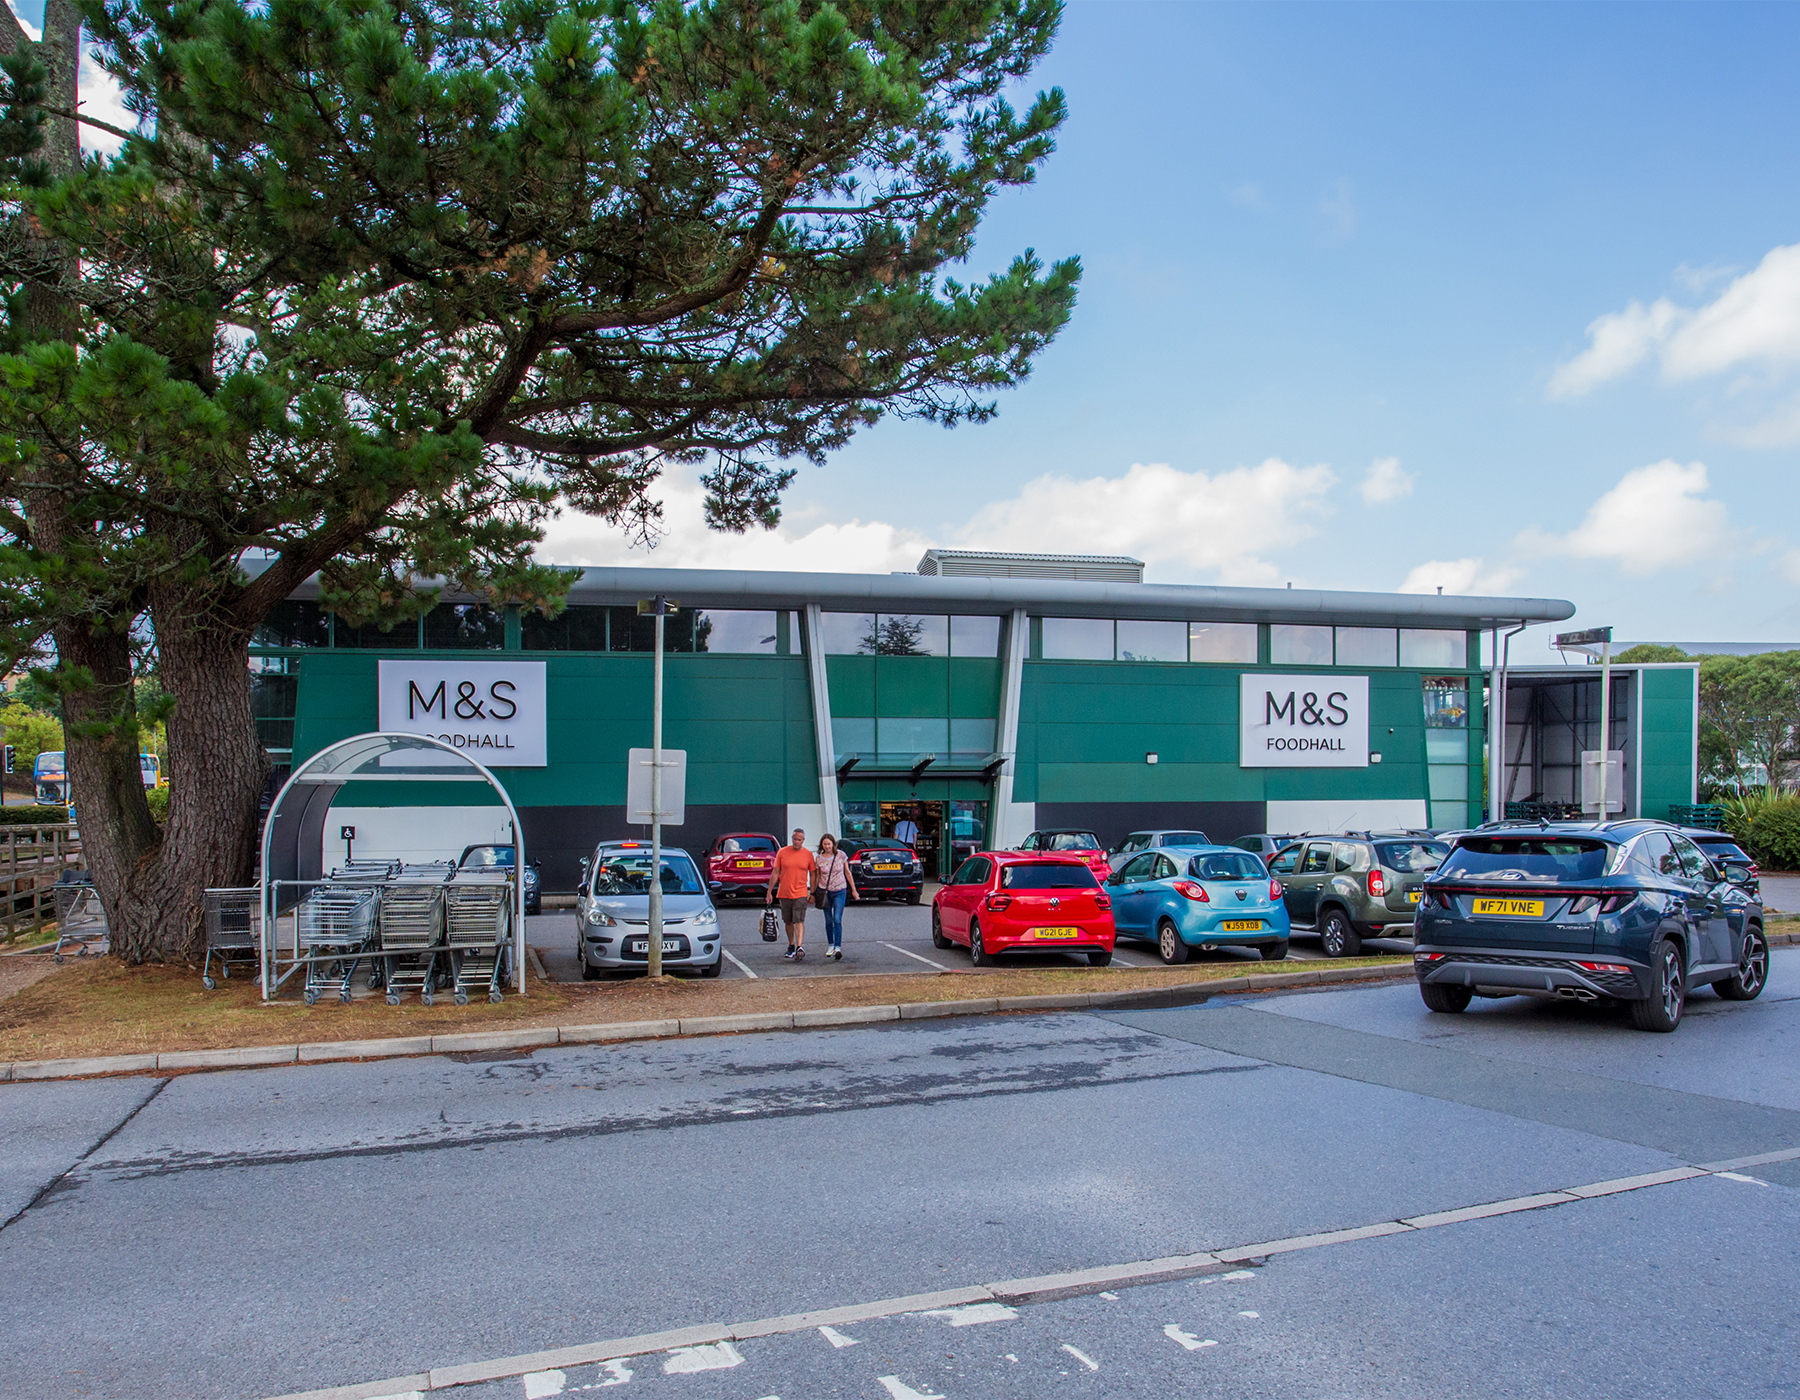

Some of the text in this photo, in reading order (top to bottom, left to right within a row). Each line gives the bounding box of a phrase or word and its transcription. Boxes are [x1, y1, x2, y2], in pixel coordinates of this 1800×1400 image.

[408, 680, 518, 720] M&S
[1265, 691, 1349, 726] M&S
[425, 733, 515, 748] ODHALL
[1266, 738, 1346, 751] FOODHALL
[1480, 900, 1536, 913] WF71 VNE
[1039, 928, 1073, 936] WG21 GJE
[1225, 922, 1245, 930] WJ59
